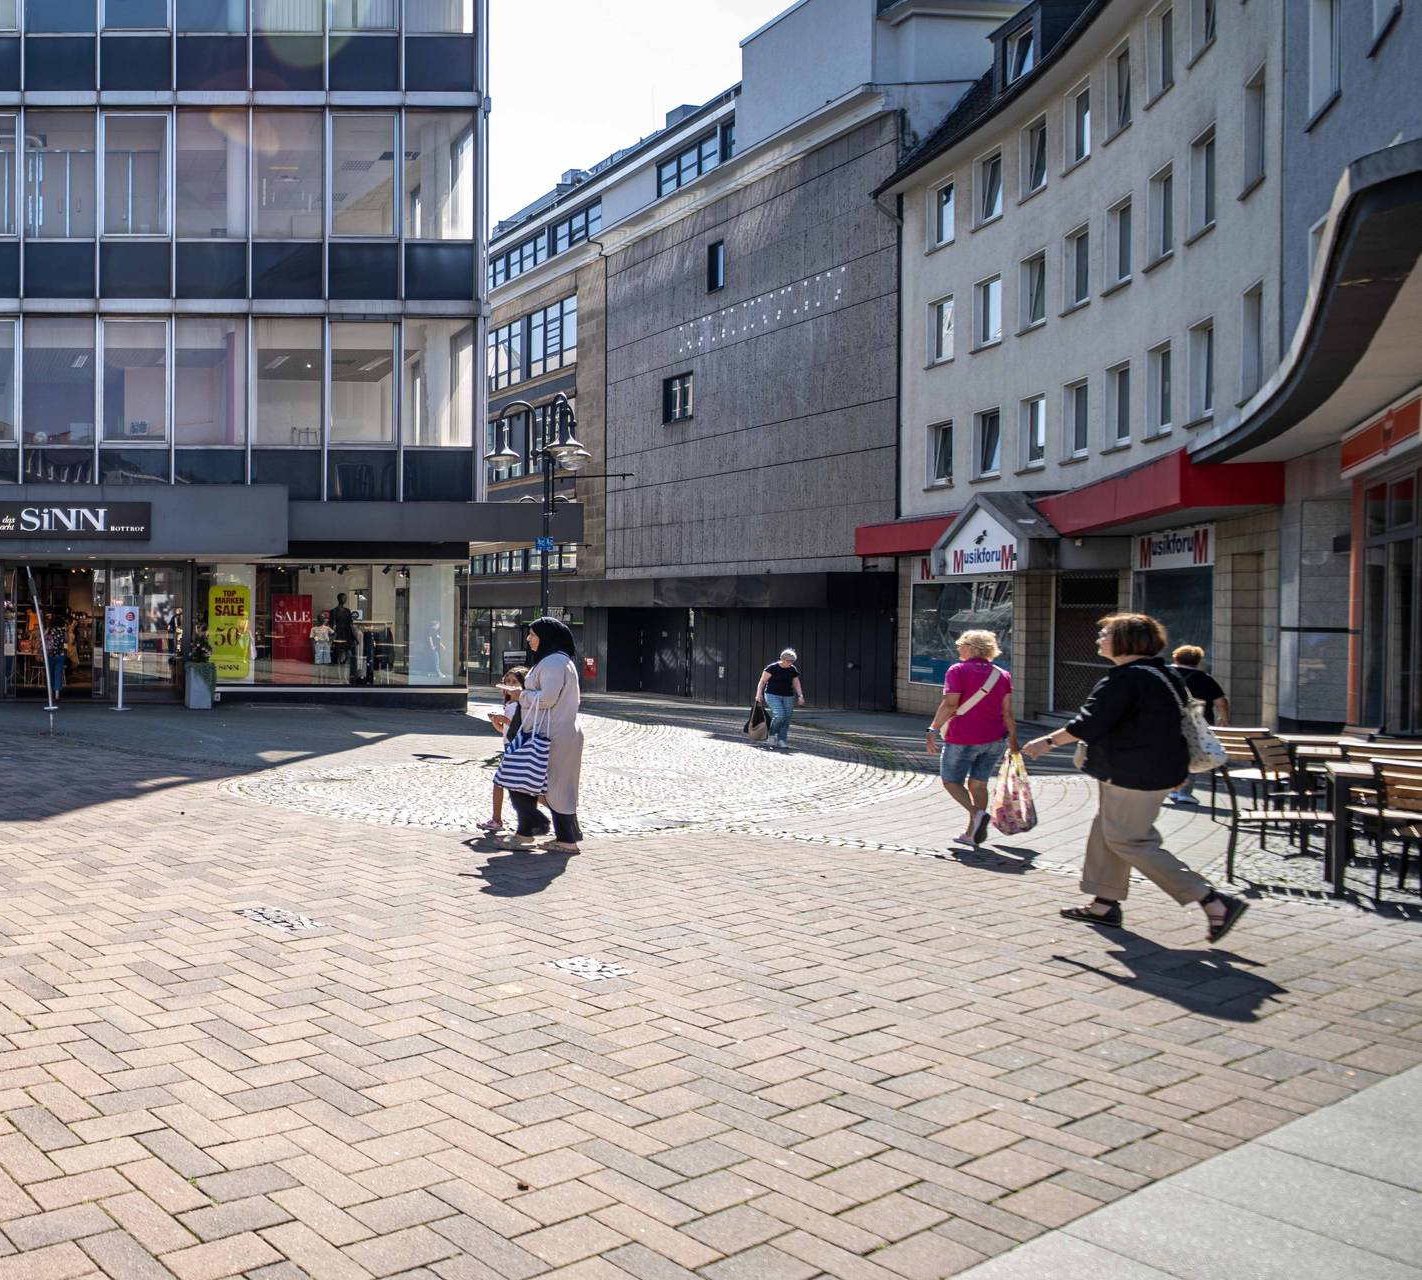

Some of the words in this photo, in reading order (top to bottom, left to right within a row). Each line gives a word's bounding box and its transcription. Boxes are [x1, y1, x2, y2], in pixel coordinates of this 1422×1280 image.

[2, 515, 16, 524] das
[20, 507, 108, 532] SiNN
[1140, 528, 1209, 569] MusikforuM
[953, 544, 1014, 573] MusikforuM
[214, 604, 244, 616] SALE
[275, 611, 311, 622] SALE
